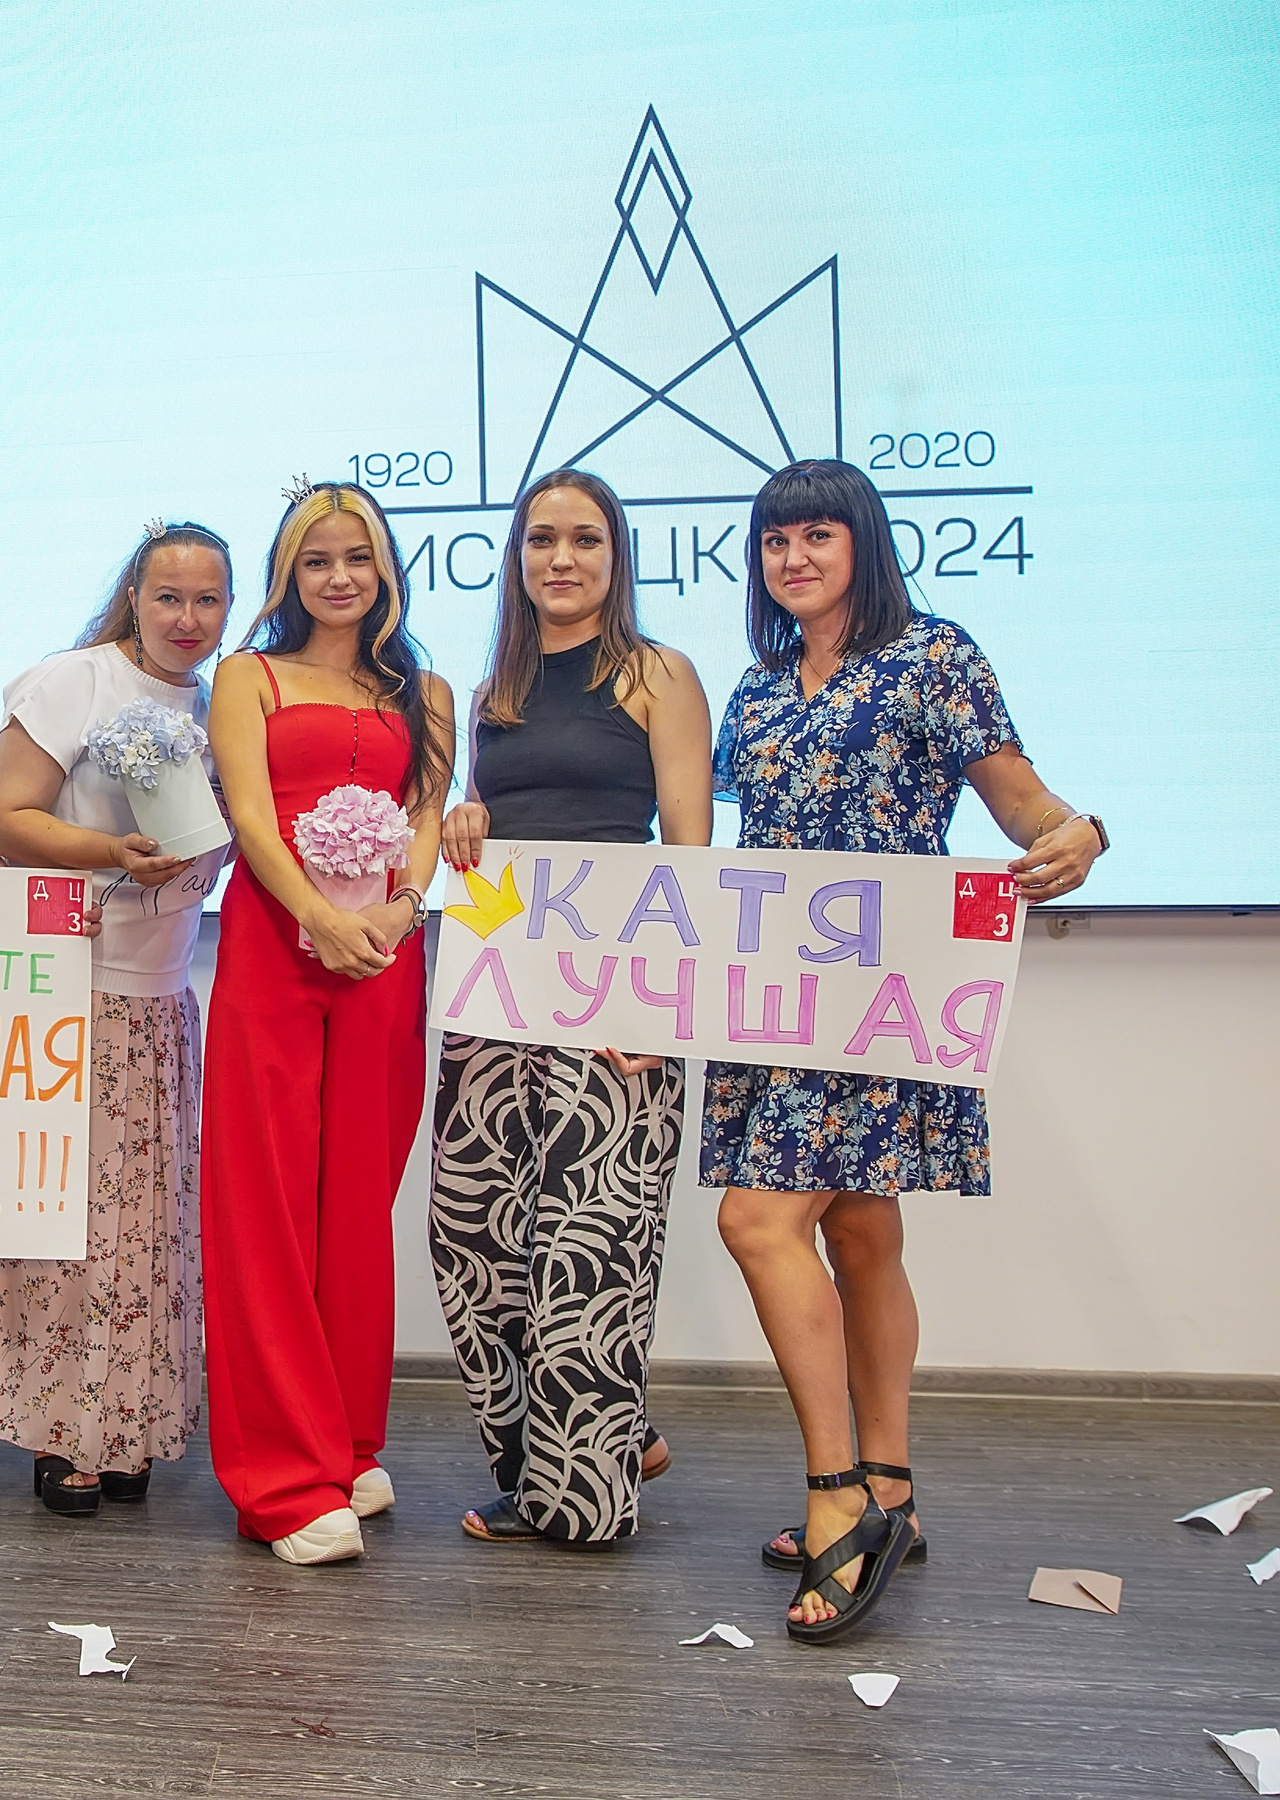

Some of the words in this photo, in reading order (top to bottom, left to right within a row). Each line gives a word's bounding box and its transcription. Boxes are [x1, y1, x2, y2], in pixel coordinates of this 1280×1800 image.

[348, 451, 453, 488] 1920
[870, 431, 995, 469] 2020
[889, 516, 1034, 577] 024
[526, 858, 883, 967] КАТЯ
[445, 947, 1005, 1073] ЛУЧШАЯ
